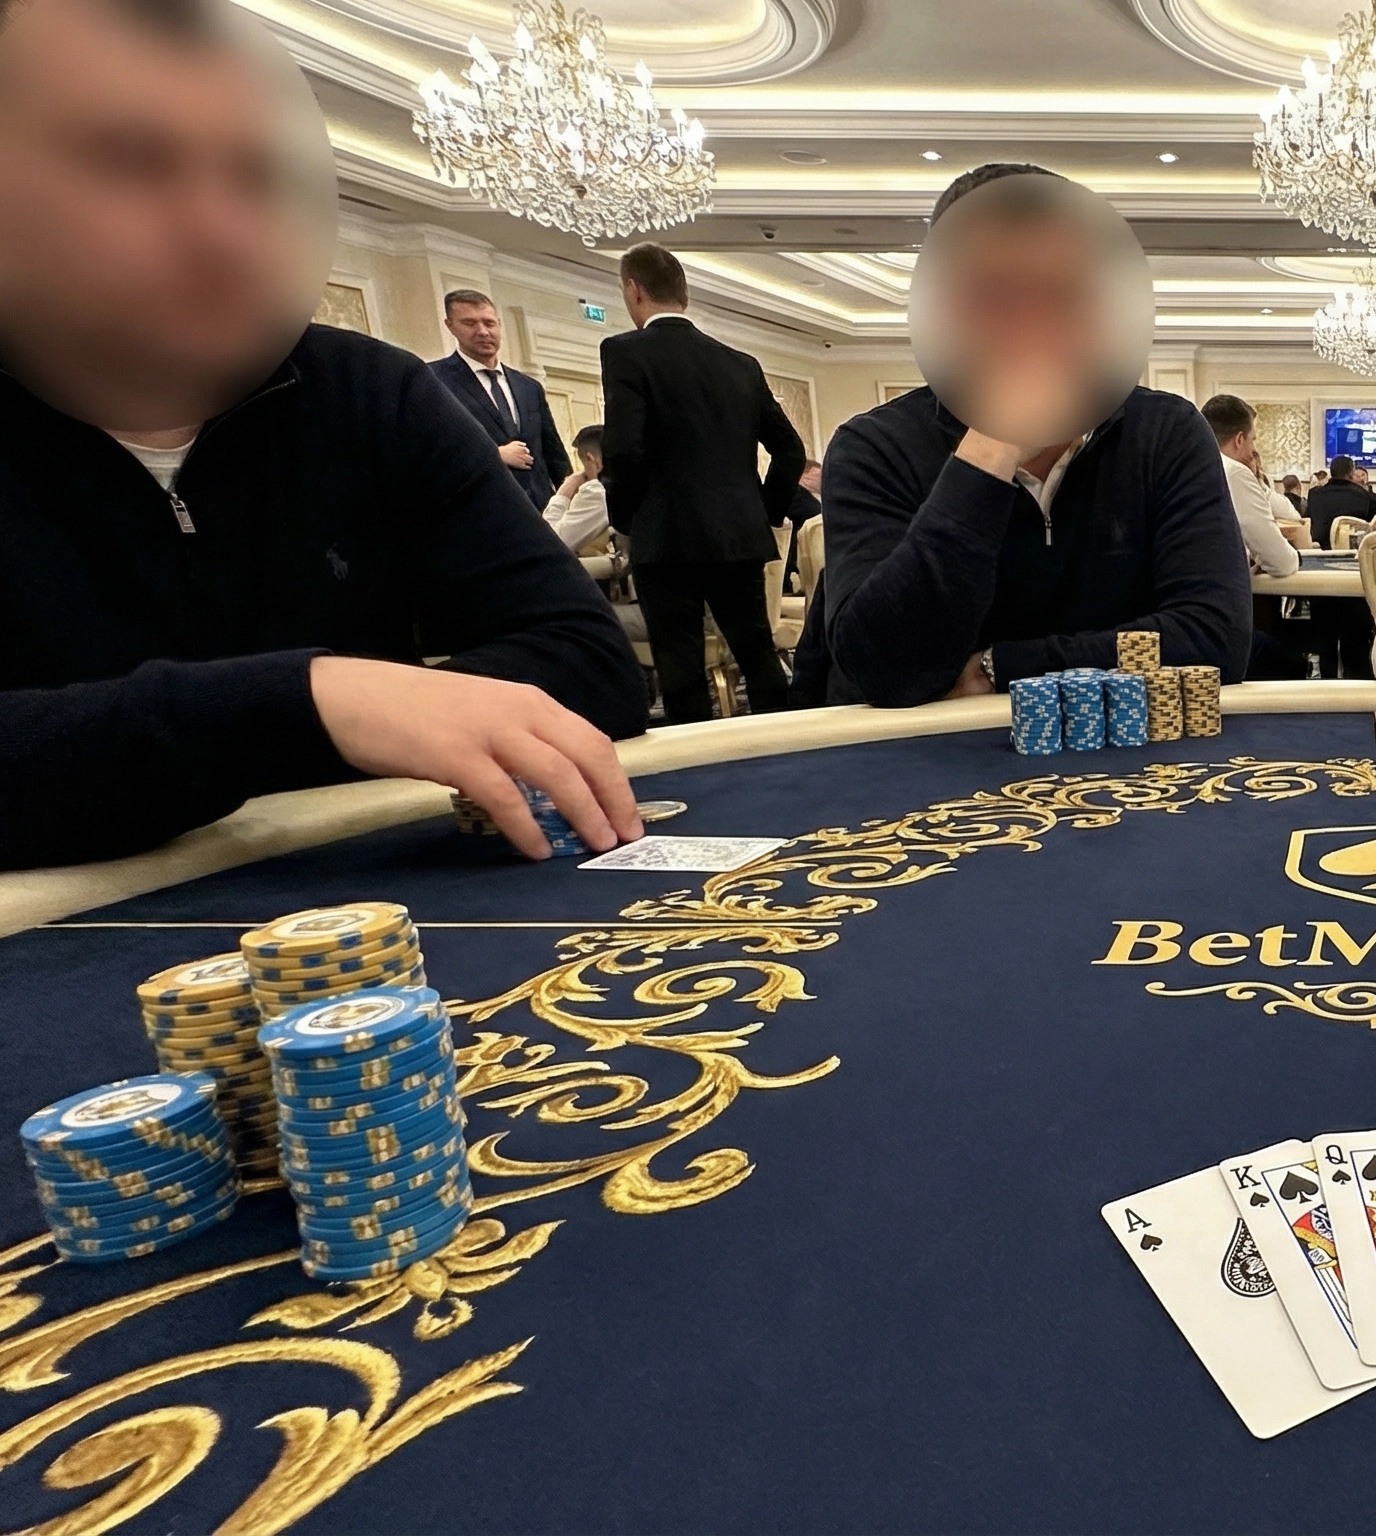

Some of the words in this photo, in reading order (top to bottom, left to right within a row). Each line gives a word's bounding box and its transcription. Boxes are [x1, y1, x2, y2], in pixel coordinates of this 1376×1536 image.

[1325, 1144, 1348, 1164] Q
[1230, 1165, 1261, 1189] K
[1125, 1208, 1152, 1233] A
